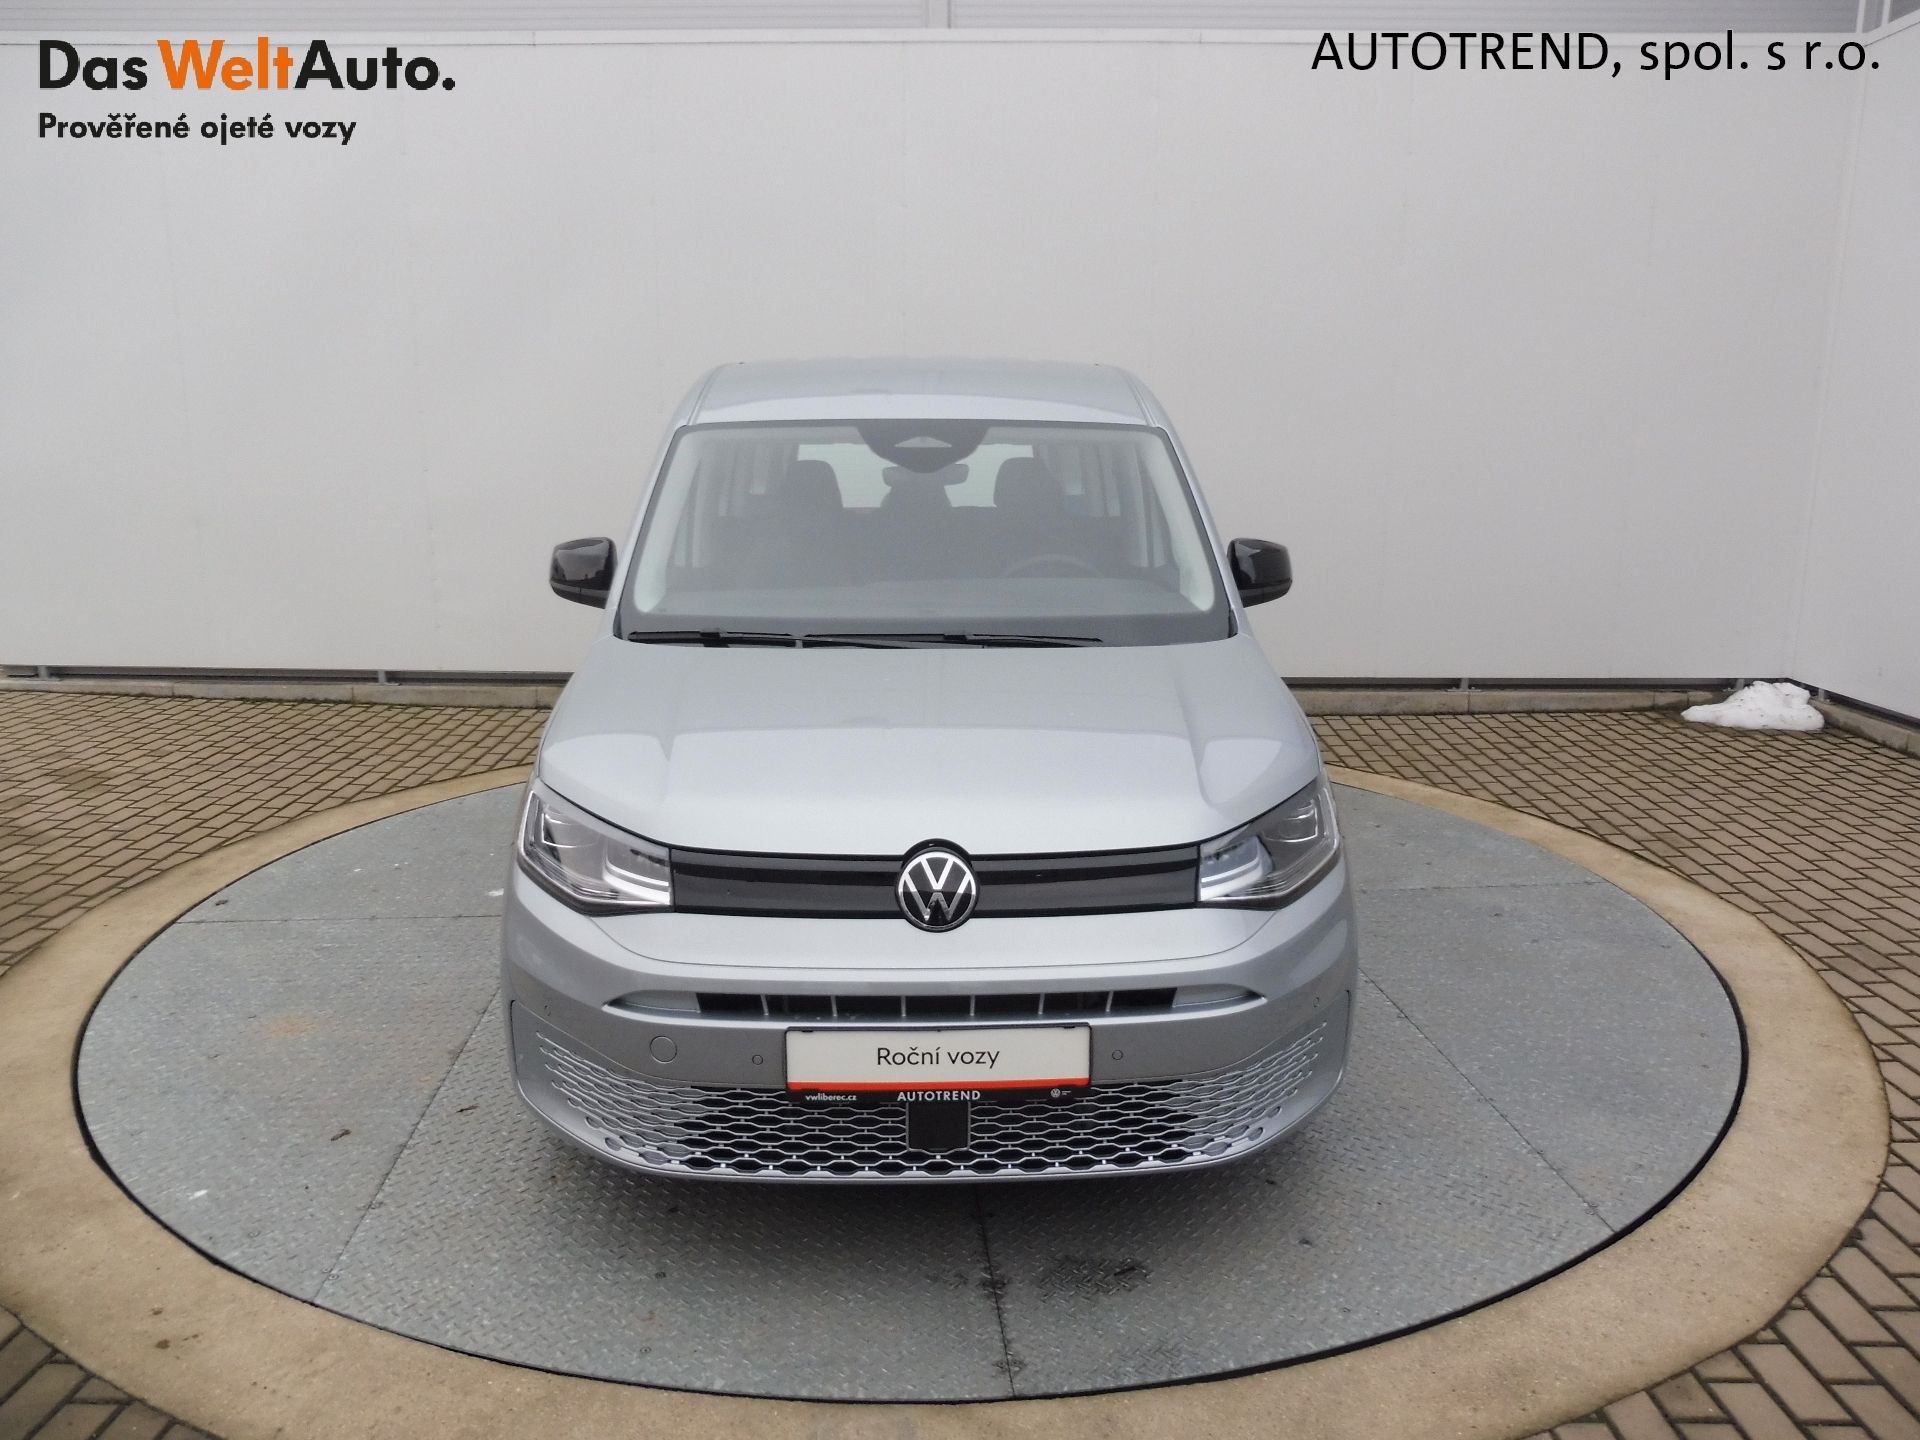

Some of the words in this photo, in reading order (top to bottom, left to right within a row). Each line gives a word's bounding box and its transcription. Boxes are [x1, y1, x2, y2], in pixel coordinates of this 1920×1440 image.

[877, 1047, 940, 1066] Roční
[947, 1050, 1000, 1069] vozy
[805, 1092, 857, 1101] vwliberec.cz
[897, 1090, 981, 1102] AUTOTREND
